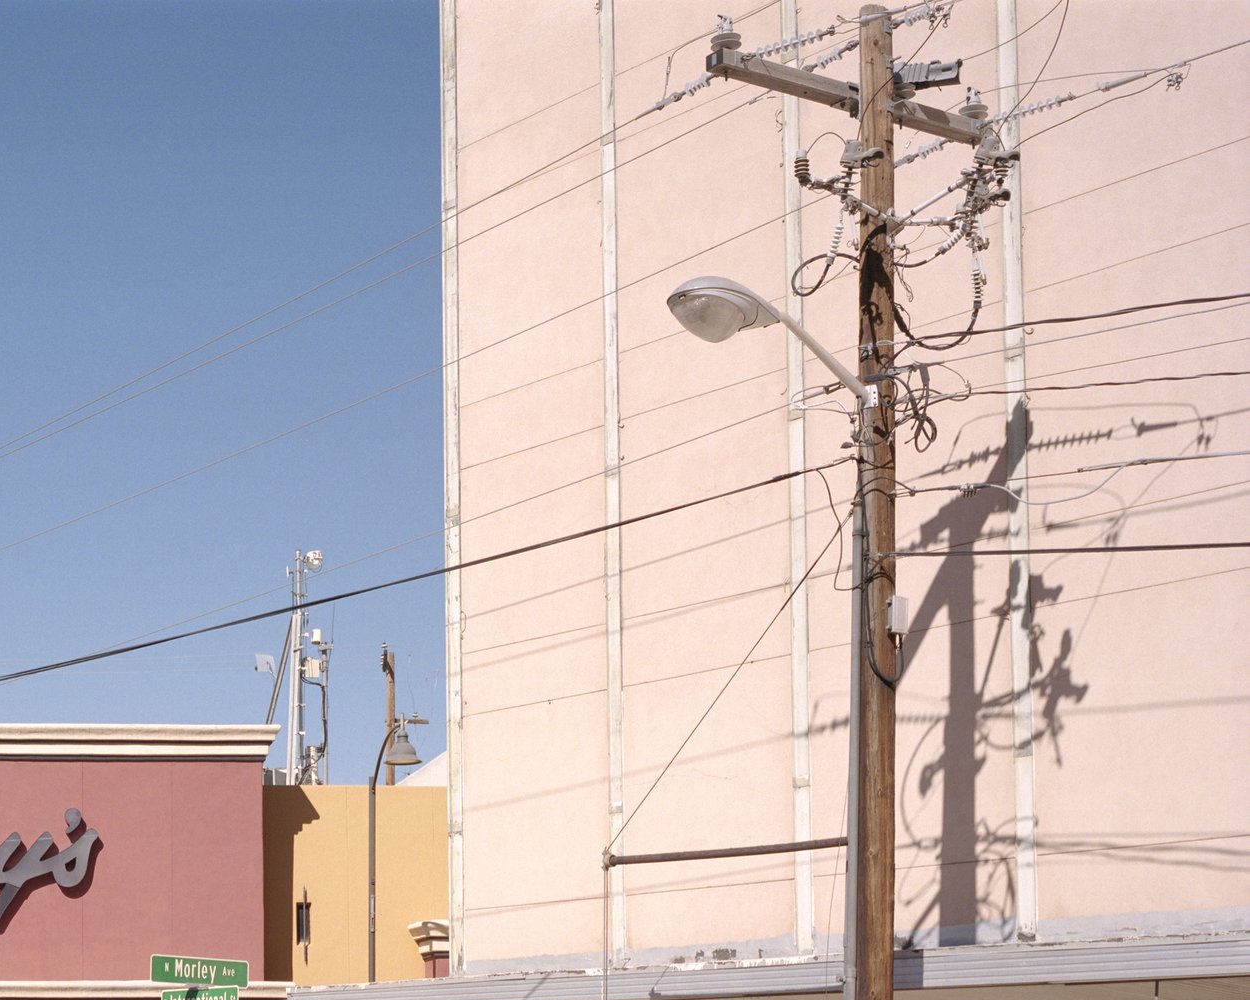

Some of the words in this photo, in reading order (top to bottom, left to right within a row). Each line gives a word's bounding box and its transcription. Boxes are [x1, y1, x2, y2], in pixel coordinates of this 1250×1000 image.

[164, 962, 170, 972] N
[174, 959, 217, 985] Morley
[222, 966, 236, 977] Ave
